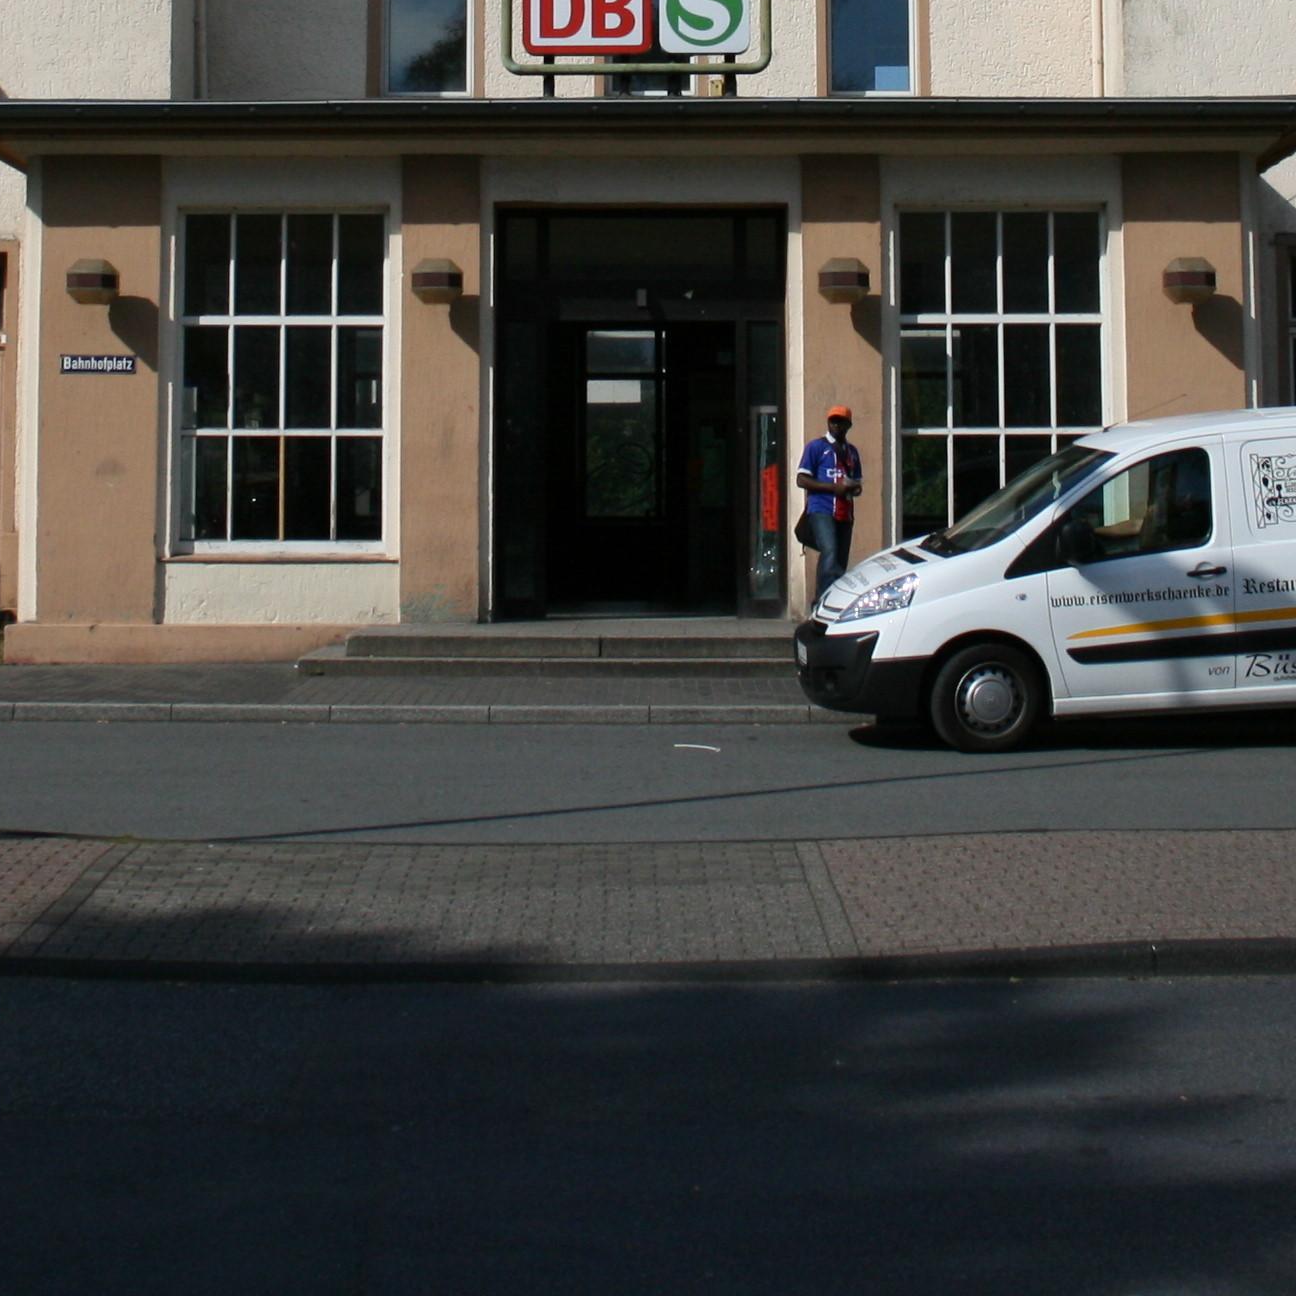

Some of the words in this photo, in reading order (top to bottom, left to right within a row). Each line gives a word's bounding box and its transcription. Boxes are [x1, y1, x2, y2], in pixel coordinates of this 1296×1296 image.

[63, 356, 133, 372] Bahnhofplatz
[1050, 582, 1231, 608] www.eisenwerkschaenke.de
[1208, 665, 1231, 677] von
